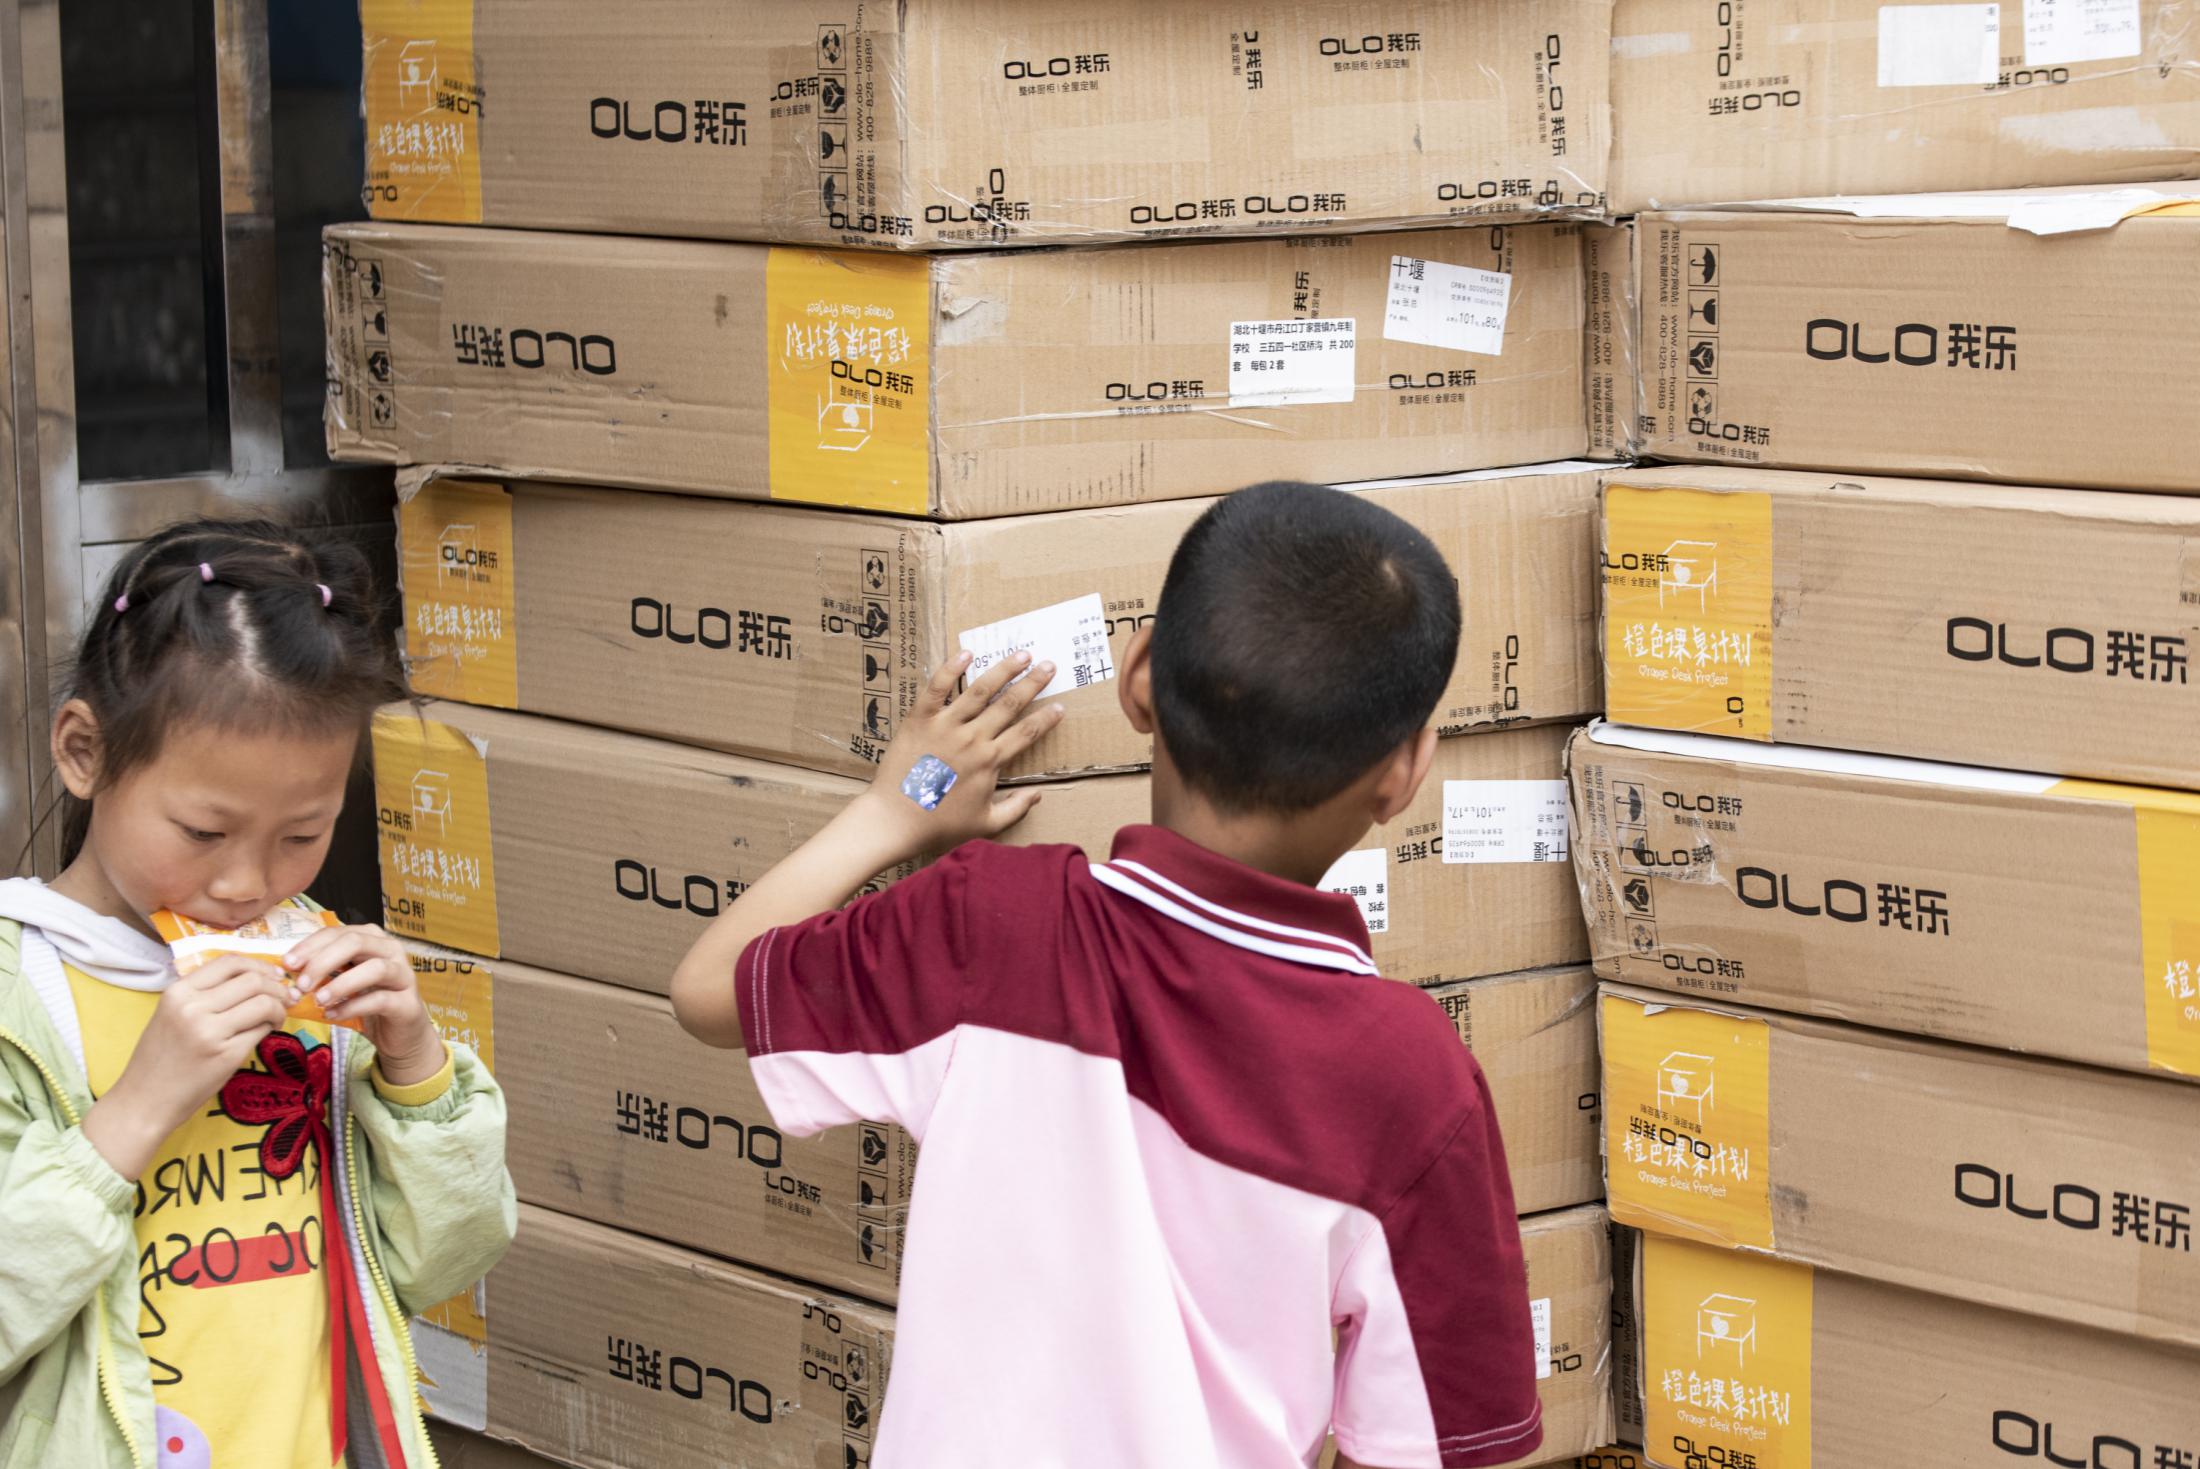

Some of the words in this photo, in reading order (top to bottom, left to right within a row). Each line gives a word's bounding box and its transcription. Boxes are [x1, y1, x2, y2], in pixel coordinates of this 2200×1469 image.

[1319, 33, 1421, 56] OLO我乐
[1004, 54, 1110, 80] OLO我乐
[590, 97, 746, 146] OLO我乐
[1244, 193, 1346, 214] OLO我乐
[1438, 179, 1532, 200] OLO我乐
[1131, 199, 1236, 224] OLO我乐
[1392, 256, 1425, 280] 十堰
[1294, 271, 1310, 319] 我乐
[453, 323, 617, 375] OLO我乐
[786, 320, 911, 366] 橙色课桌计划
[1233, 343, 1250, 354] 学校
[1806, 318, 2017, 371] OLO我乐
[831, 360, 914, 395] OLO我乐
[1106, 380, 1204, 401] OLO我乐
[1389, 369, 1477, 390] OLO我乐
[631, 597, 791, 660] OLO我乐
[1623, 621, 1751, 669] 橙色课桌计划
[1947, 616, 2187, 684] OLO我乐
[1662, 791, 1743, 816] OLO我乐
[1533, 842, 1566, 862] 十堰
[1737, 866, 1950, 936] OLO我乐
[1366, 919, 1384, 930] 湖北
[1663, 954, 1745, 979] OLO我乐
[2163, 959, 2200, 999] 橙
[616, 1090, 782, 1168] OLO我乐
[1954, 1163, 2190, 1252] OLO我乐
[608, 1335, 772, 1424] OLO我乐
[1661, 1369, 1790, 1426] 橙色课桌计划
[1993, 1410, 2200, 1469] OLO
